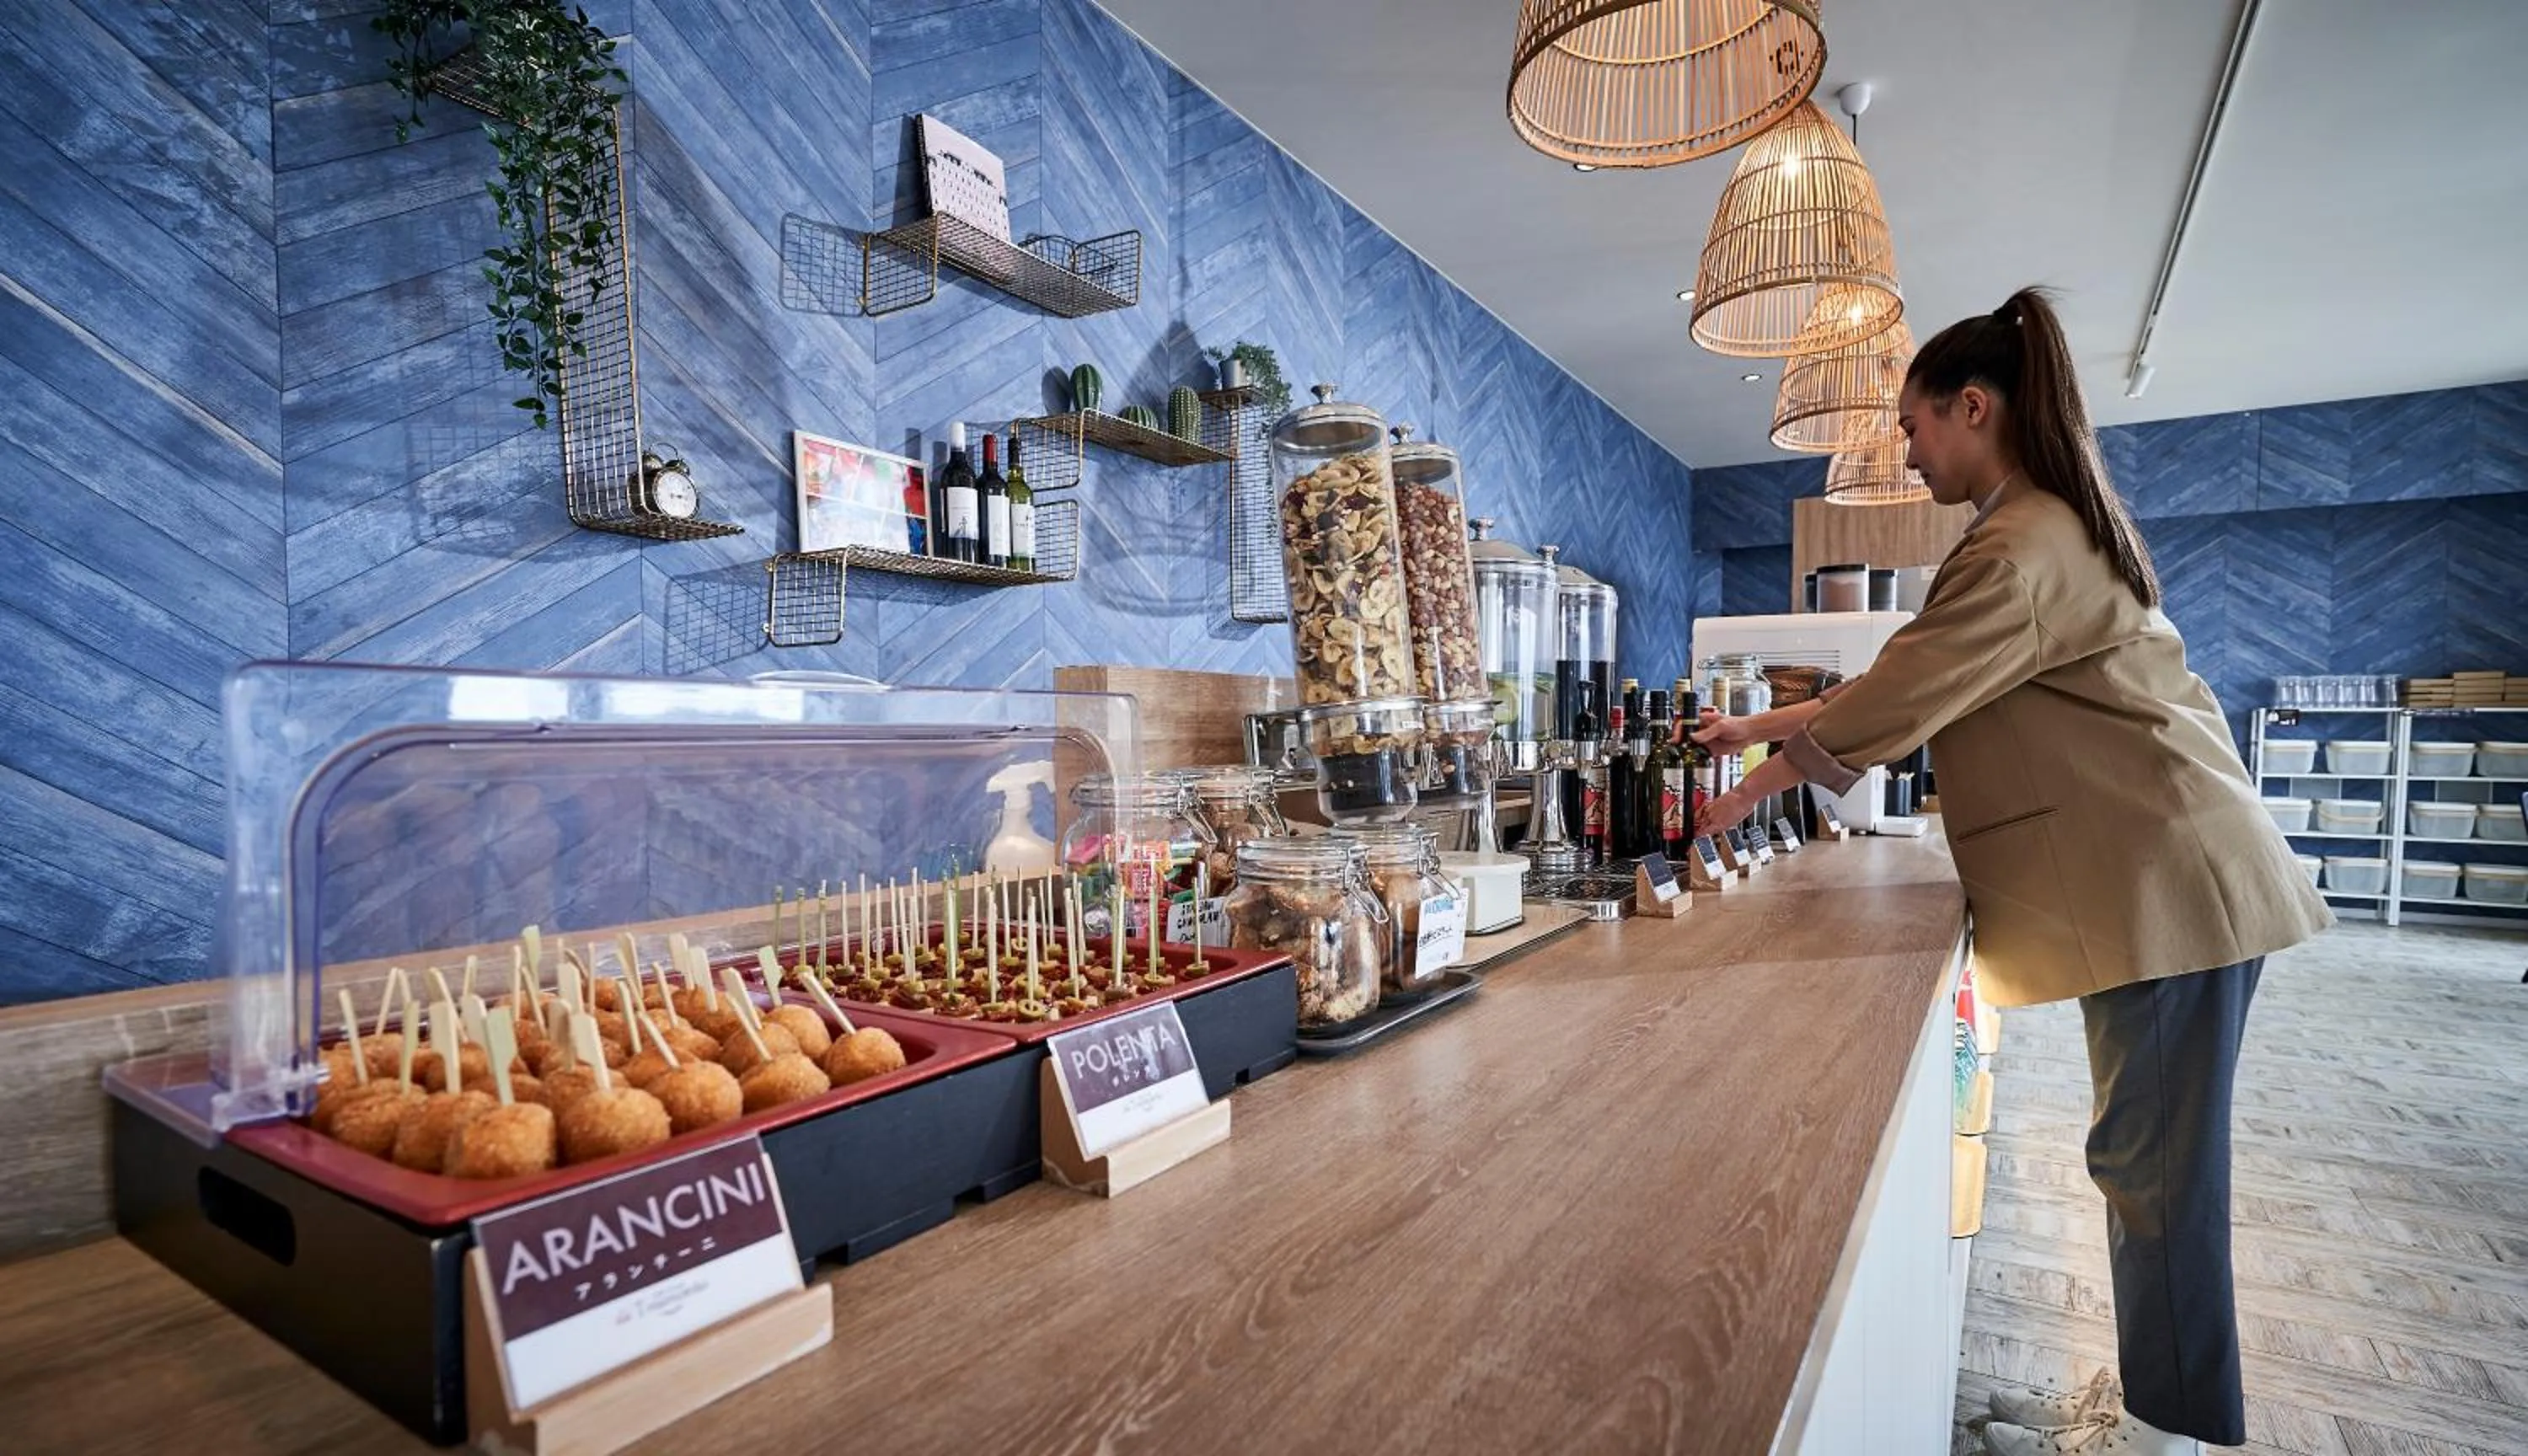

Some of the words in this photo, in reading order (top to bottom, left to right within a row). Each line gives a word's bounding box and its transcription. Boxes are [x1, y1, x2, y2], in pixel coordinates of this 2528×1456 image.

[1070, 1021, 1176, 1079] POLENTA
[502, 1162, 766, 1295] ARANCINI
[575, 1236, 716, 1301] アランチーニ
